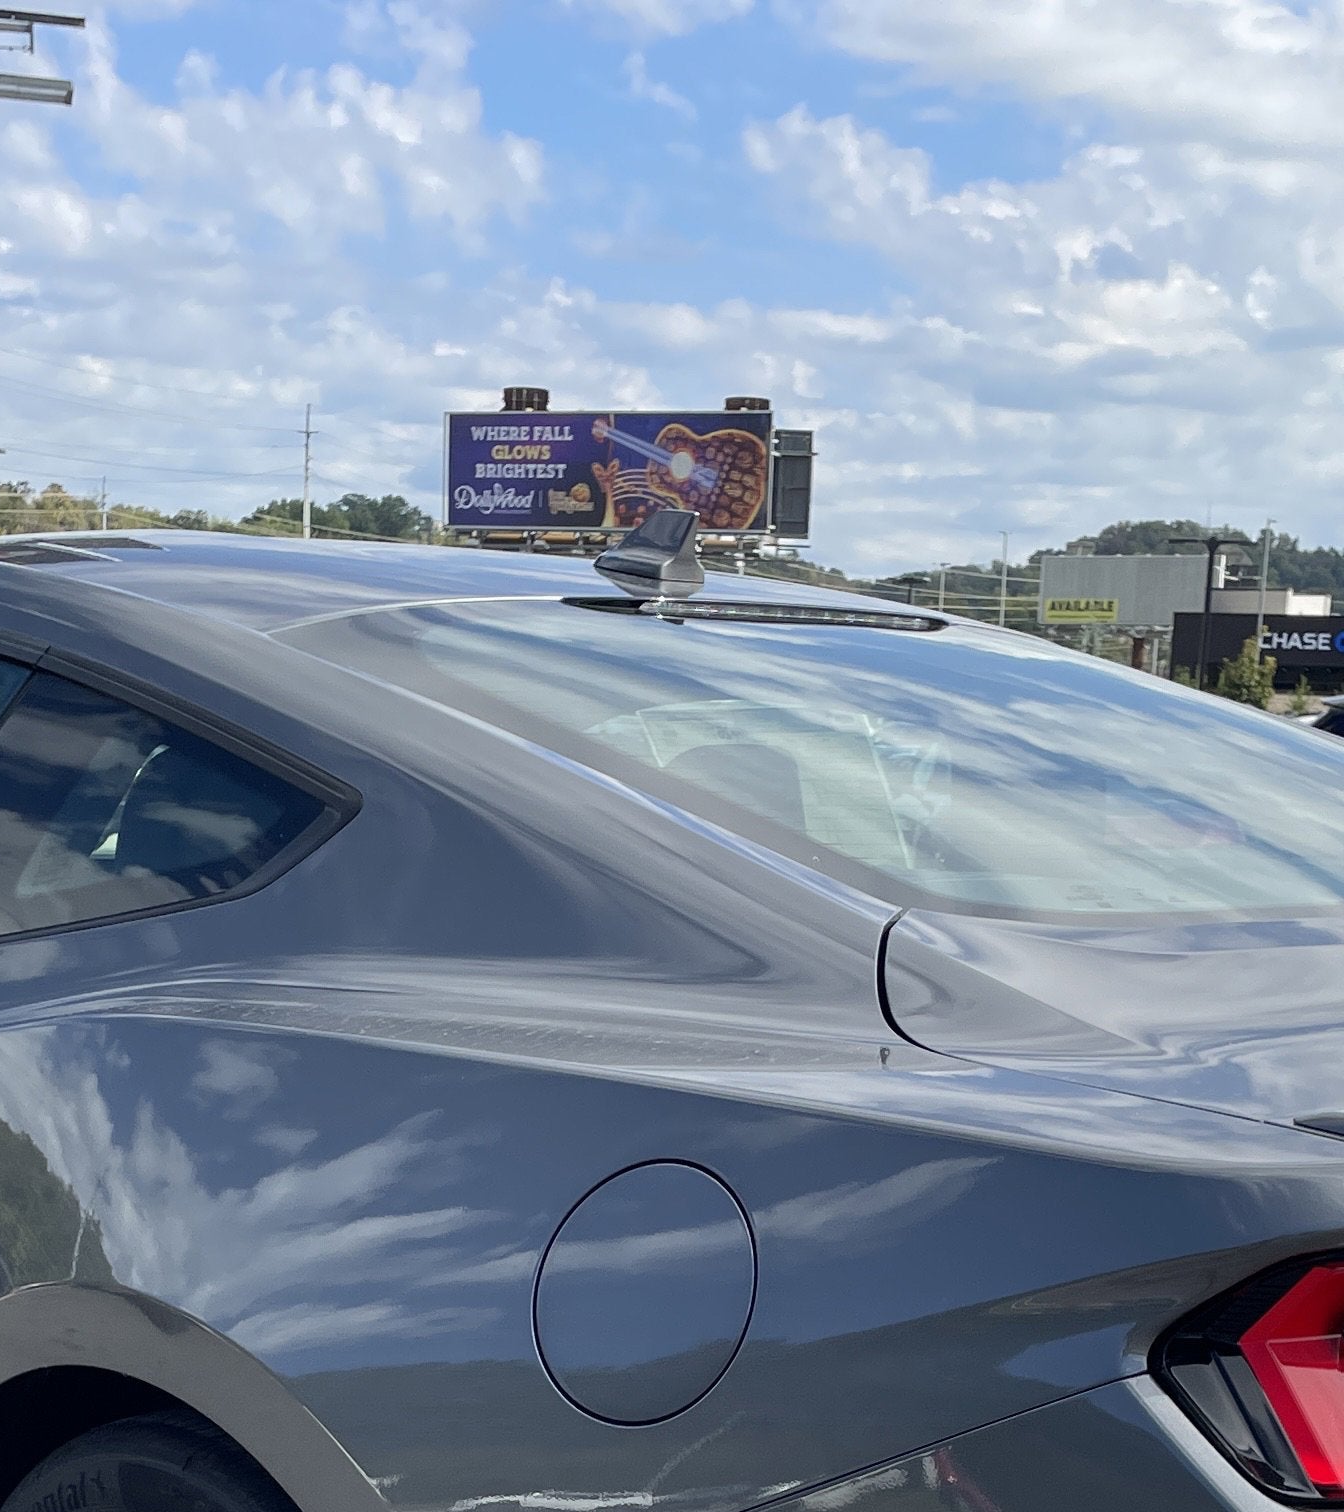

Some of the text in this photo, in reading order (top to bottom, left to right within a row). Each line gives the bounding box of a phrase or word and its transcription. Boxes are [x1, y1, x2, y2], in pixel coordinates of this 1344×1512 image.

[470, 425, 574, 441] WHERE FALL
[491, 445, 551, 460] GLOWS
[474, 463, 567, 479] BRIGHTEST
[1048, 600, 1114, 612] AVAILABLE
[1258, 632, 1332, 651] CHASE
